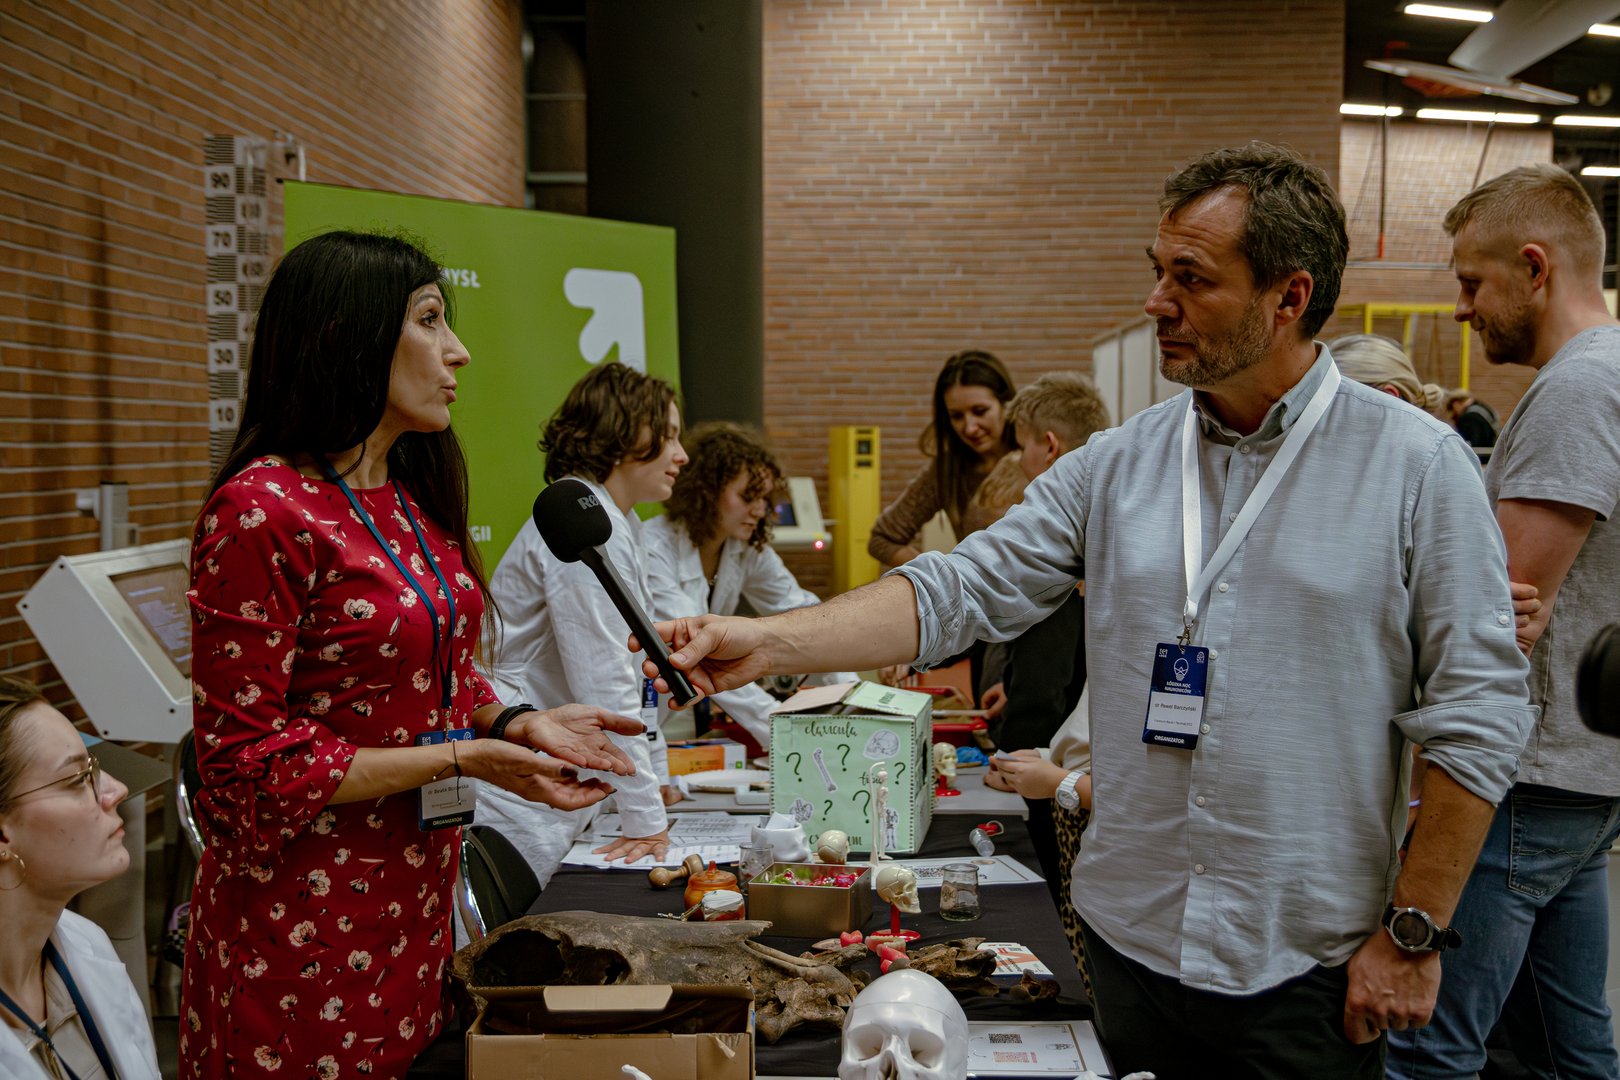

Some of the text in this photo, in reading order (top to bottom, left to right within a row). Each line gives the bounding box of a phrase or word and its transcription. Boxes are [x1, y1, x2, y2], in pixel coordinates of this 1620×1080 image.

[210, 172, 230, 189] 90
[212, 231, 231, 248] 70
[214, 290, 233, 306] 50
[214, 348, 234, 365] 30
[216, 407, 234, 422] 10
[1154, 735, 1185, 744] ORGANIZATOR
